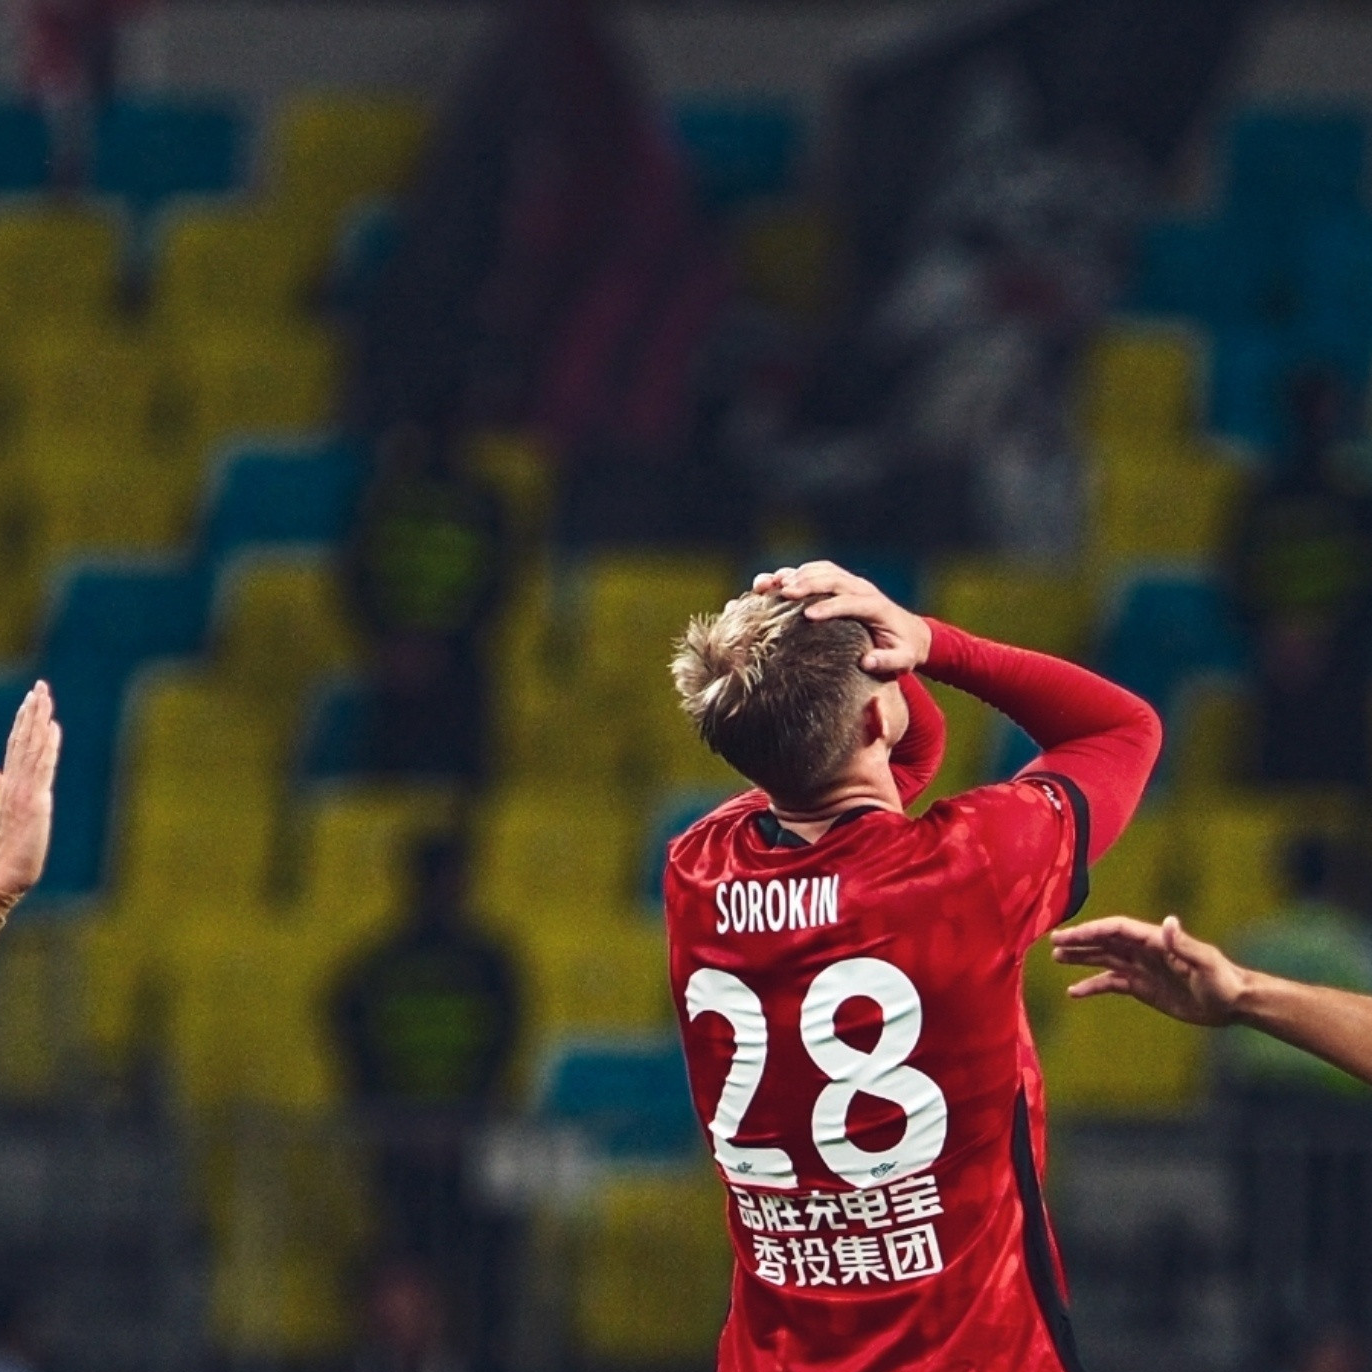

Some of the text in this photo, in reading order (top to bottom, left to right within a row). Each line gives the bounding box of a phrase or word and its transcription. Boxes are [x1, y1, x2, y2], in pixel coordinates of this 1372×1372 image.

[716, 873, 840, 935] SOROKIN
[685, 957, 948, 1188] 28
[753, 1222, 944, 1287] 香投集团
